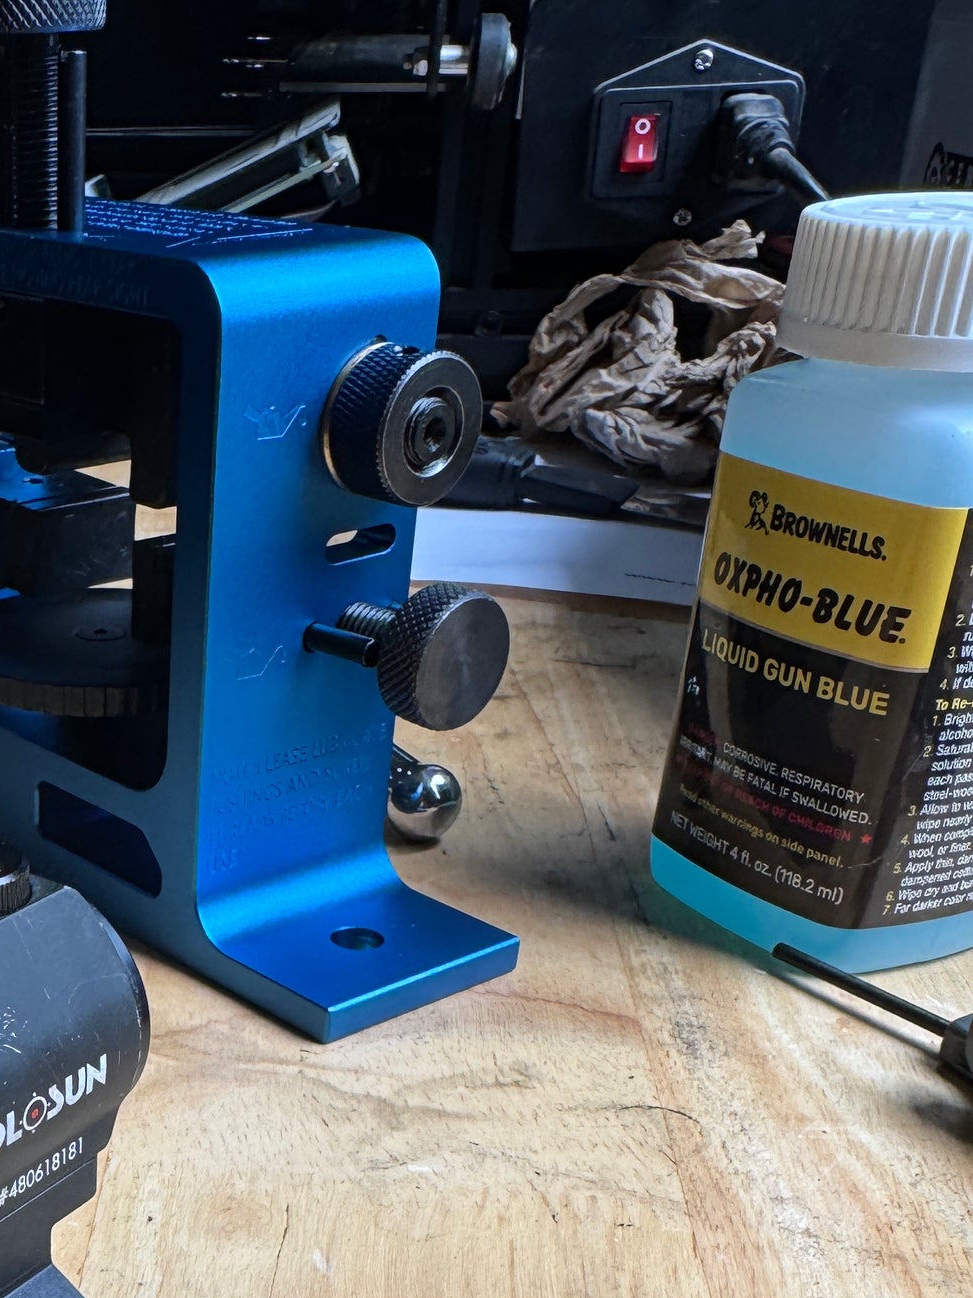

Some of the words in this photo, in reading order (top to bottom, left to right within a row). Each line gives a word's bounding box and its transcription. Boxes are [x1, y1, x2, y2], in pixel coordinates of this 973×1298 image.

[701, 628, 759, 673] LIQUID
[763, 657, 812, 694] GUN
[816, 675, 890, 716] BLUE
[935, 698, 949, 711] To
[930, 756, 973, 772] solution
[781, 766, 865, 805] RESPIRATORY
[927, 773, 953, 787] each
[732, 765, 746, 782] BE
[747, 771, 777, 796] FATAL
[778, 785, 791, 799] IF
[790, 790, 873, 826] SWALLOWED.
[919, 803, 950, 816] Allow
[721, 810, 765, 839] warnings
[765, 830, 779, 844] on
[780, 836, 805, 856] side
[805, 847, 845, 869] panel.
[913, 833, 942, 845] When
[670, 809, 690, 831] NET
[689, 823, 730, 855] WEIGHT
[729, 845, 740, 861] 4
[774, 864, 815, 896] (118.2
[816, 885, 845, 906] ml)
[937, 846, 949, 856] or
[904, 860, 934, 874] Apply
[900, 870, 952, 887] dampened
[898, 889, 923, 902] Wipe
[894, 902, 912, 915] For
